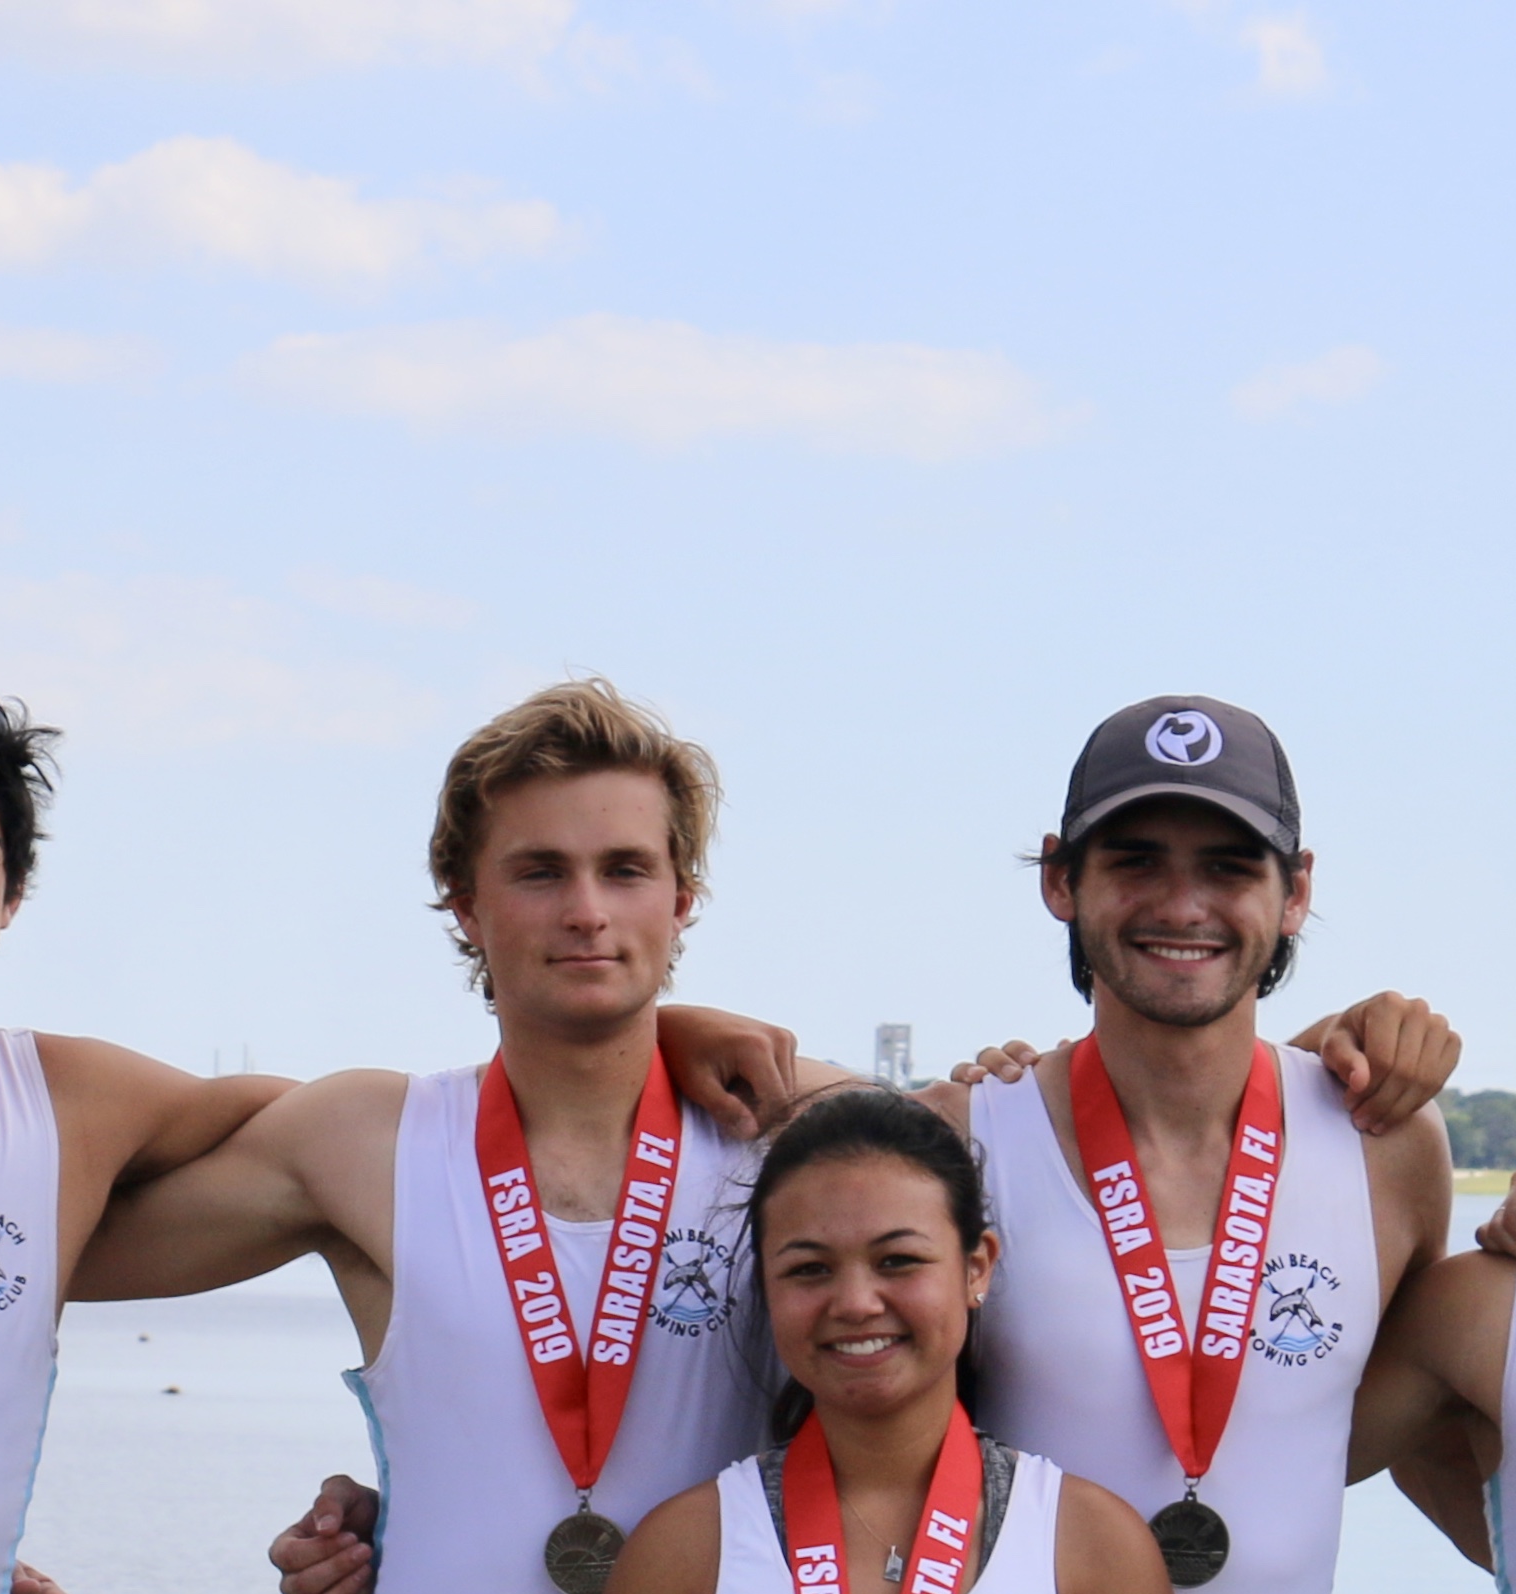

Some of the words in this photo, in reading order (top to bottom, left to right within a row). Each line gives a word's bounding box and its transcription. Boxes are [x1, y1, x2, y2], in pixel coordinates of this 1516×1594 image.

[488, 1166, 543, 1262] FSRA
[592, 1176, 672, 1366] SARASOTA,
[635, 1131, 675, 1169] FL
[1092, 1160, 1152, 1256] FSRA
[1124, 1266, 1183, 1359] 2019
[1201, 1172, 1275, 1360] SARASOTA,
[1240, 1124, 1276, 1164] FL
[513, 1271, 573, 1364] 2019
[1289, 1253, 1341, 1291] BEACH
[647, 1304, 700, 1337] OWING
[1314, 1322, 1343, 1359] CLUB
[926, 1509, 969, 1552] FL
